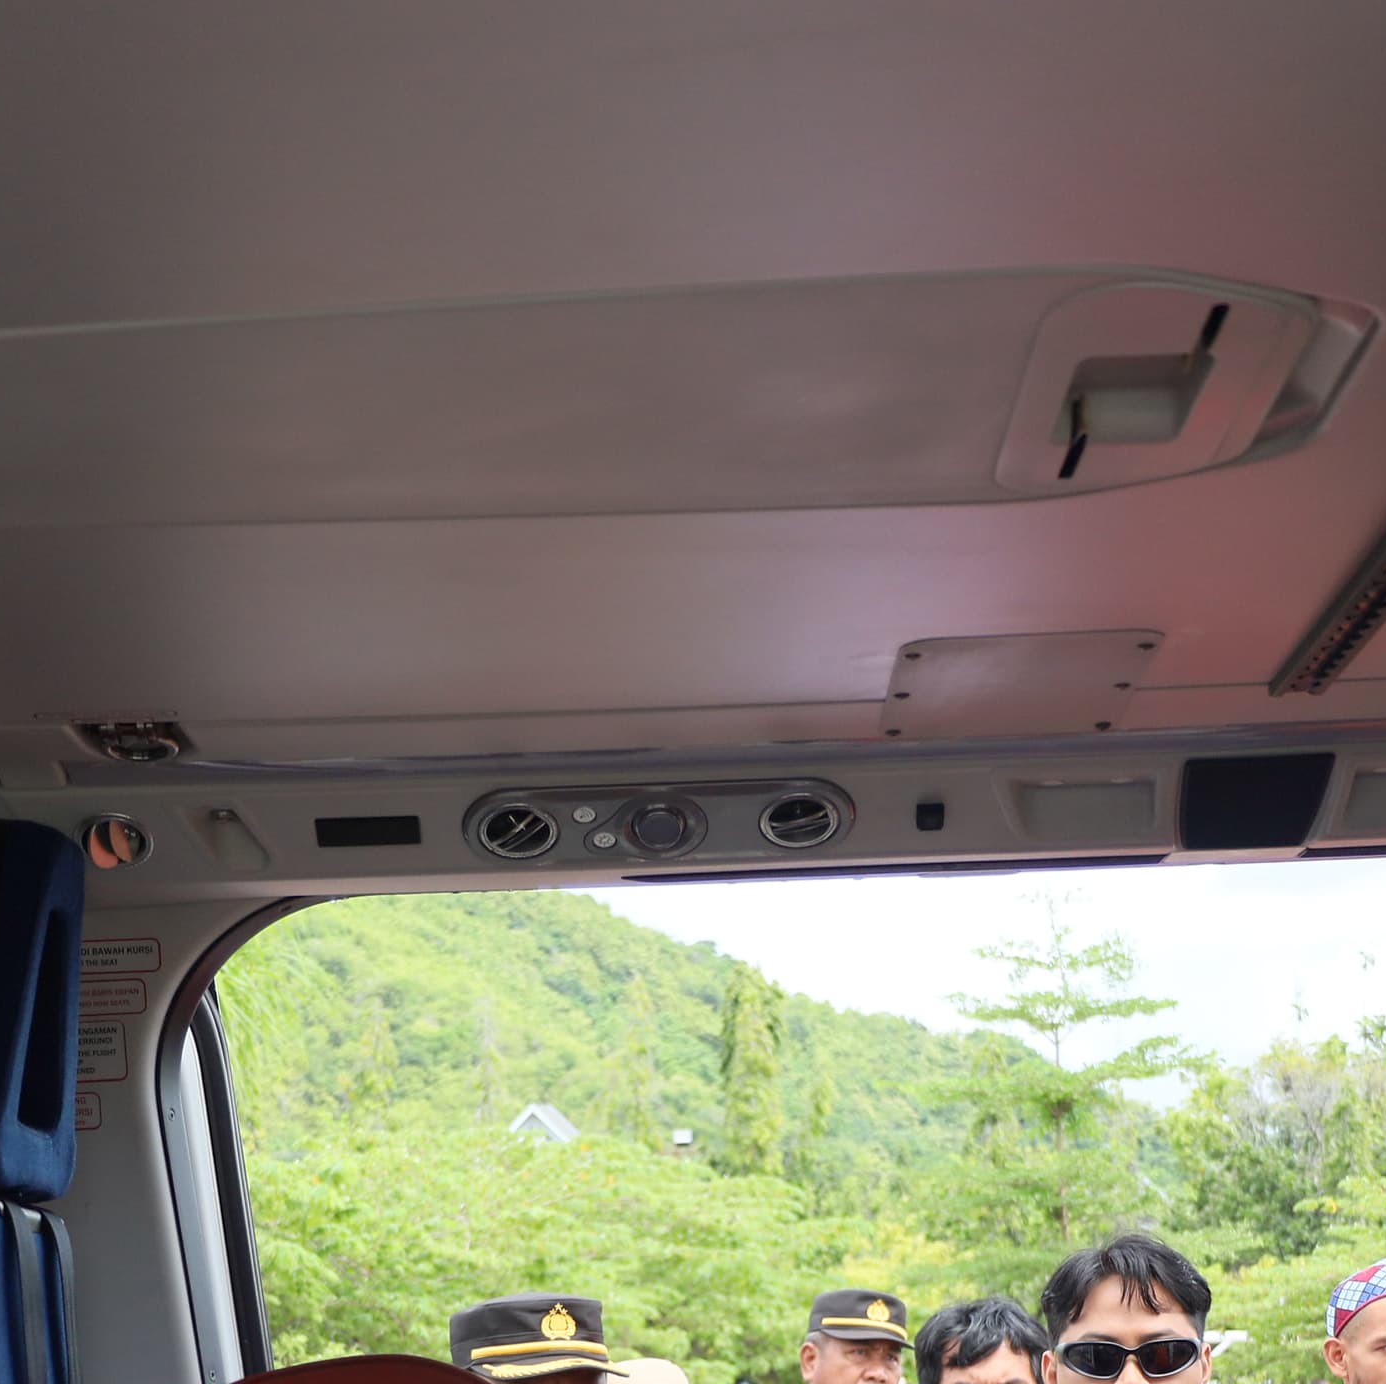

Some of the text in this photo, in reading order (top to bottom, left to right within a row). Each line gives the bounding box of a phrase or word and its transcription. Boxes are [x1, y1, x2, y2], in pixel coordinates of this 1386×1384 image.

[92, 946, 125, 956] BAWAH
[126, 945, 153, 955] KURSI
[78, 1026, 117, 1036] ENGAMAN
